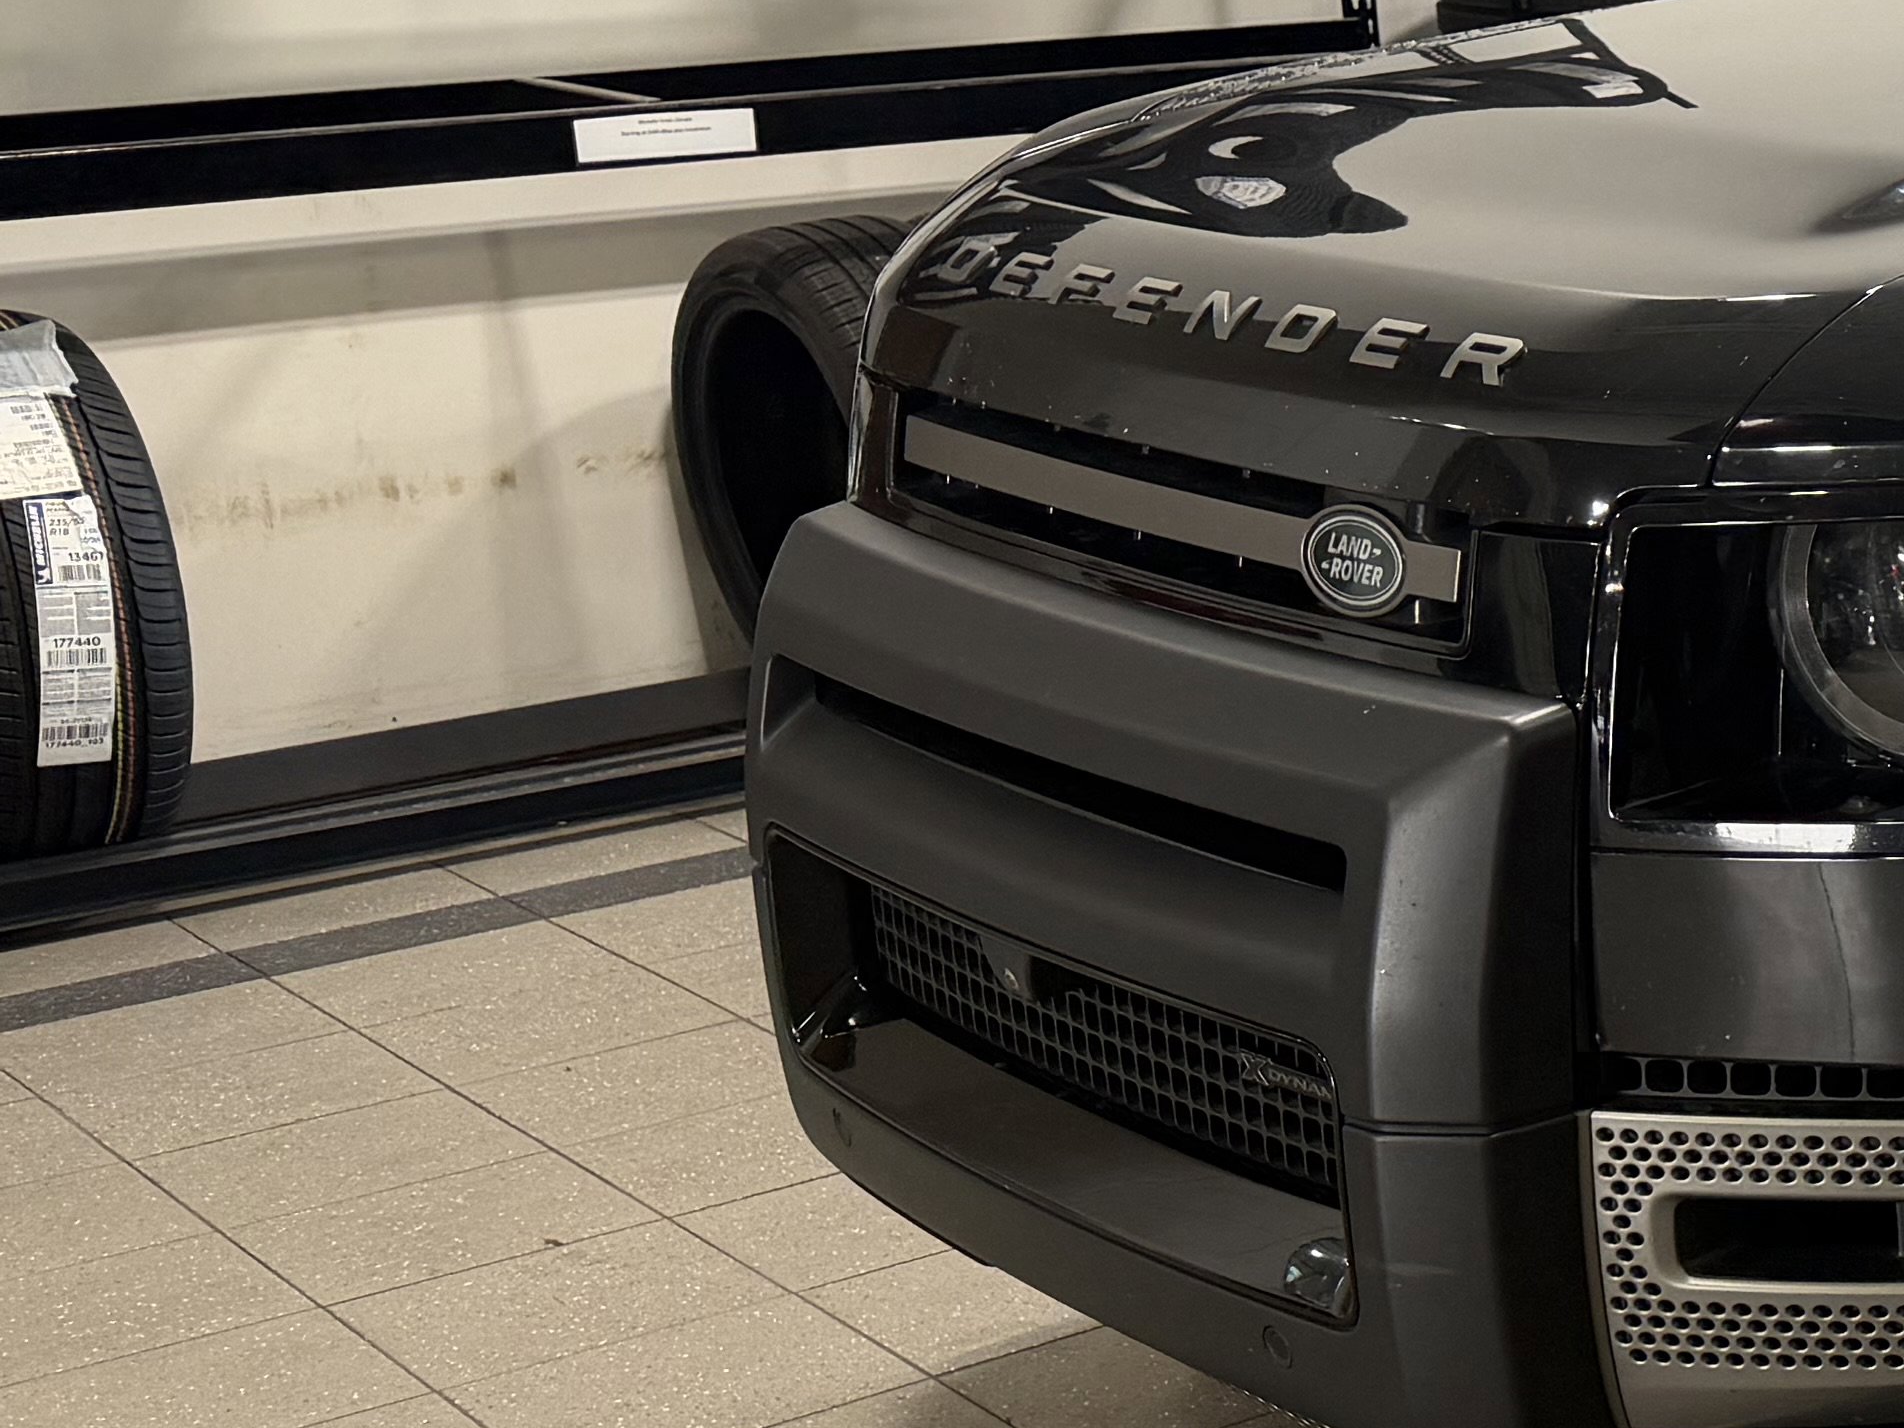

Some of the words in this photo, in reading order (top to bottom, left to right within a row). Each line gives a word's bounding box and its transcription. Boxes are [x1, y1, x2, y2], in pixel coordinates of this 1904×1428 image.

[935, 241, 1528, 386] DEFENDER
[28, 505, 46, 566] MICHELIN
[1327, 532, 1372, 561] LAND
[1329, 557, 1384, 588] ROVER
[53, 636, 101, 648] 177440
